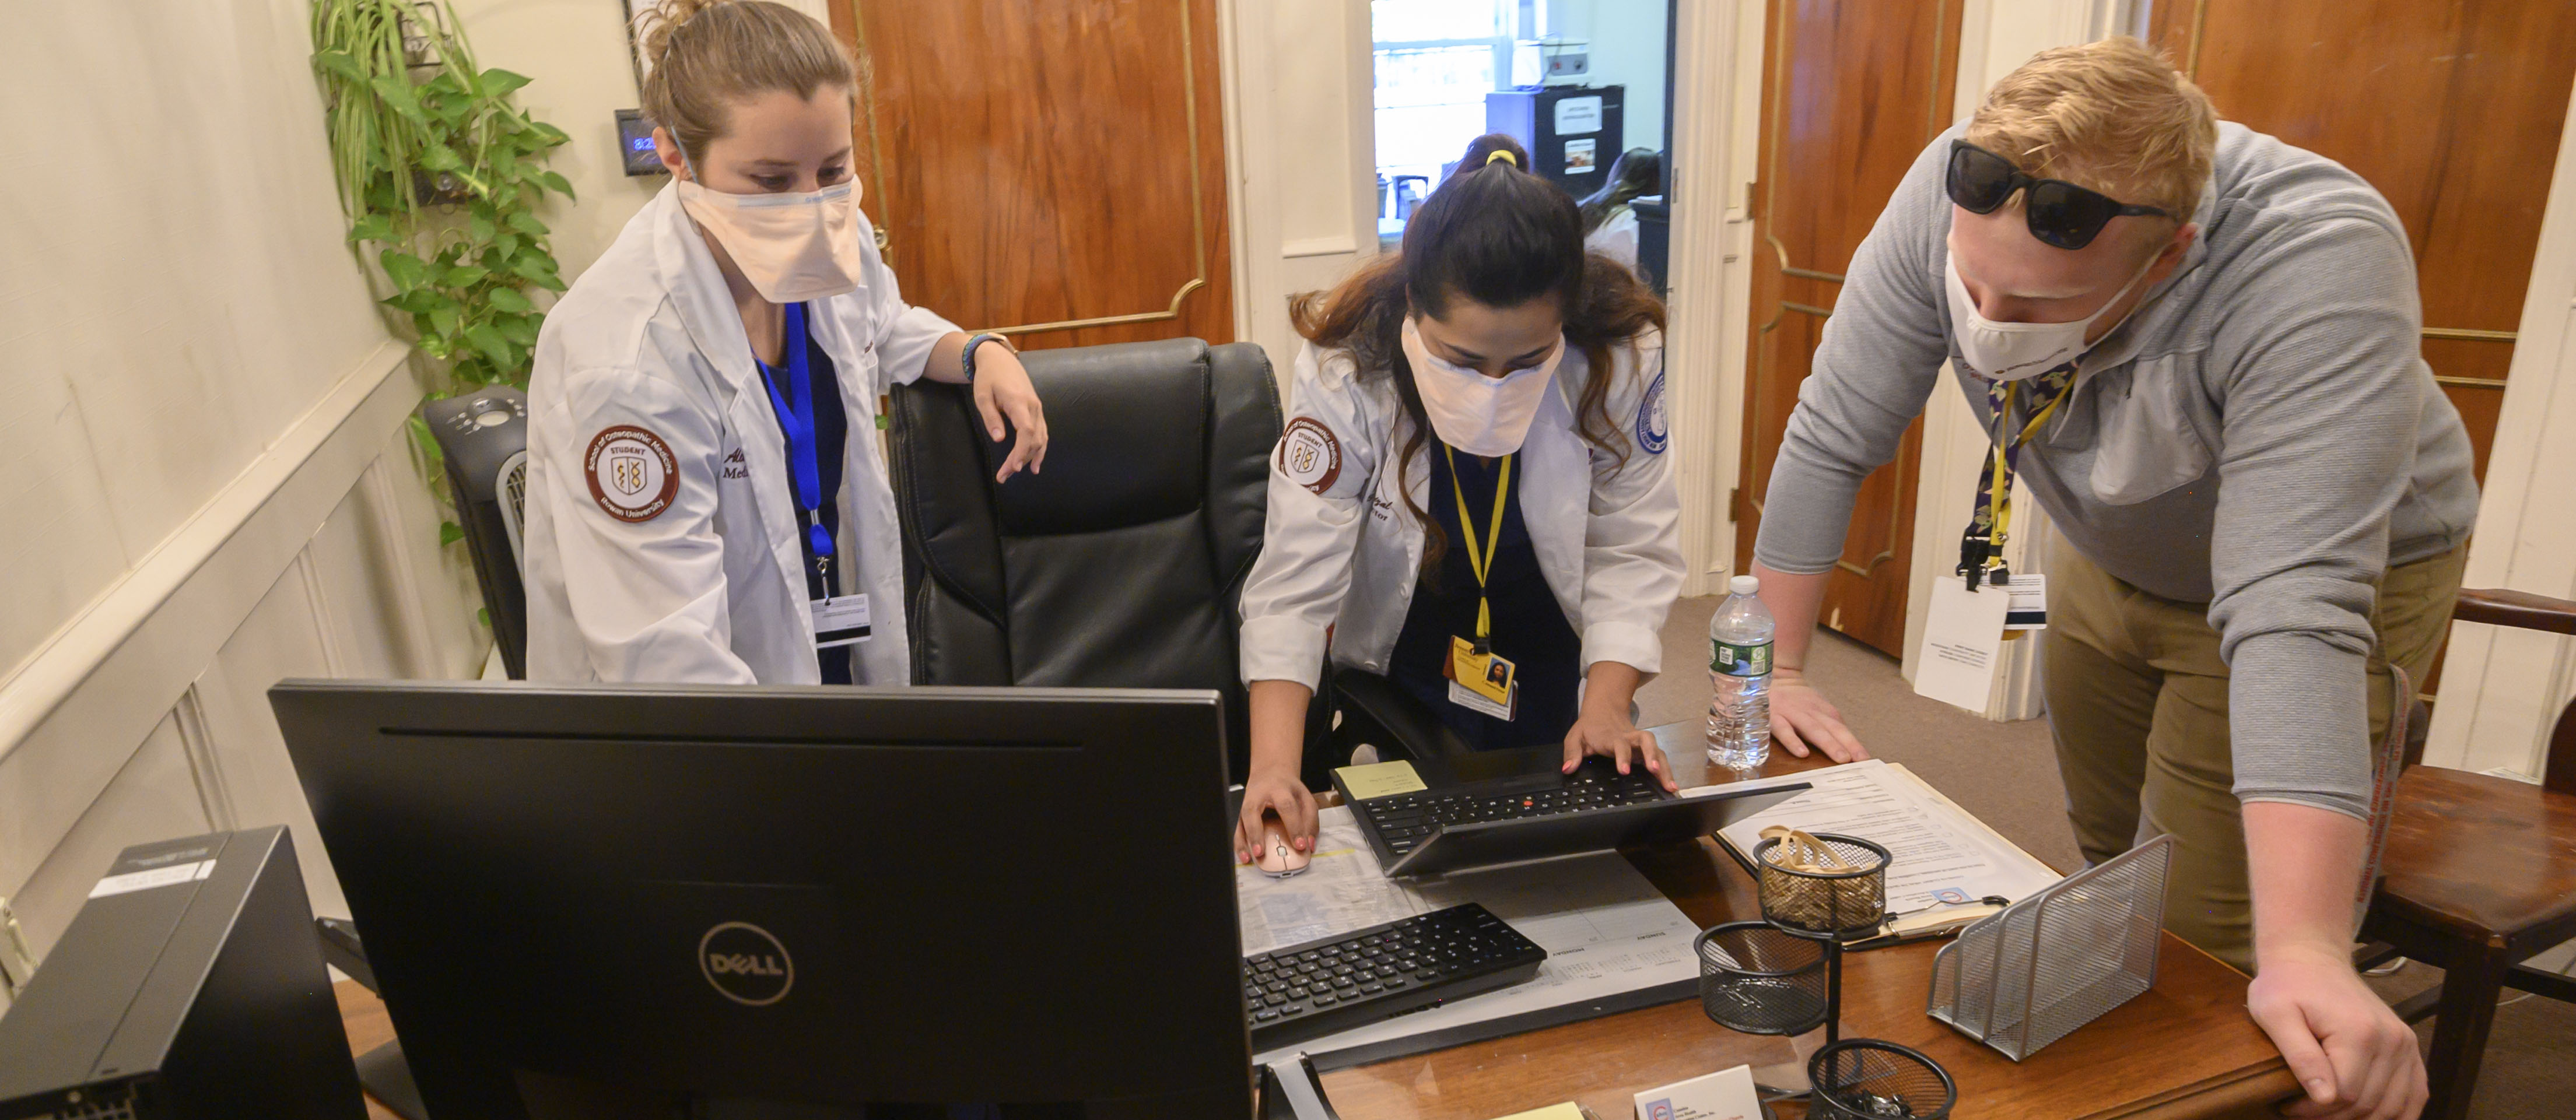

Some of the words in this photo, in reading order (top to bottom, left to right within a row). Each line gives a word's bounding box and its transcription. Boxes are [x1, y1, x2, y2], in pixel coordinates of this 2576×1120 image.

[1298, 432, 1323, 448] STUDENT
[1298, 420, 1330, 441] Osteopathic
[1328, 441, 1338, 469] Medicine
[588, 445, 599, 471] School
[598, 436, 606, 447] of
[605, 431, 651, 444] Osteopathic
[651, 441, 672, 475] Medicine
[611, 447, 646, 455] STUDENT
[601, 497, 624, 516] Rowan
[626, 499, 664, 518] University
[1637, 932, 1666, 940] SUNDAY
[1552, 947, 1585, 957] MONDAY
[709, 953, 783, 975] DELL
